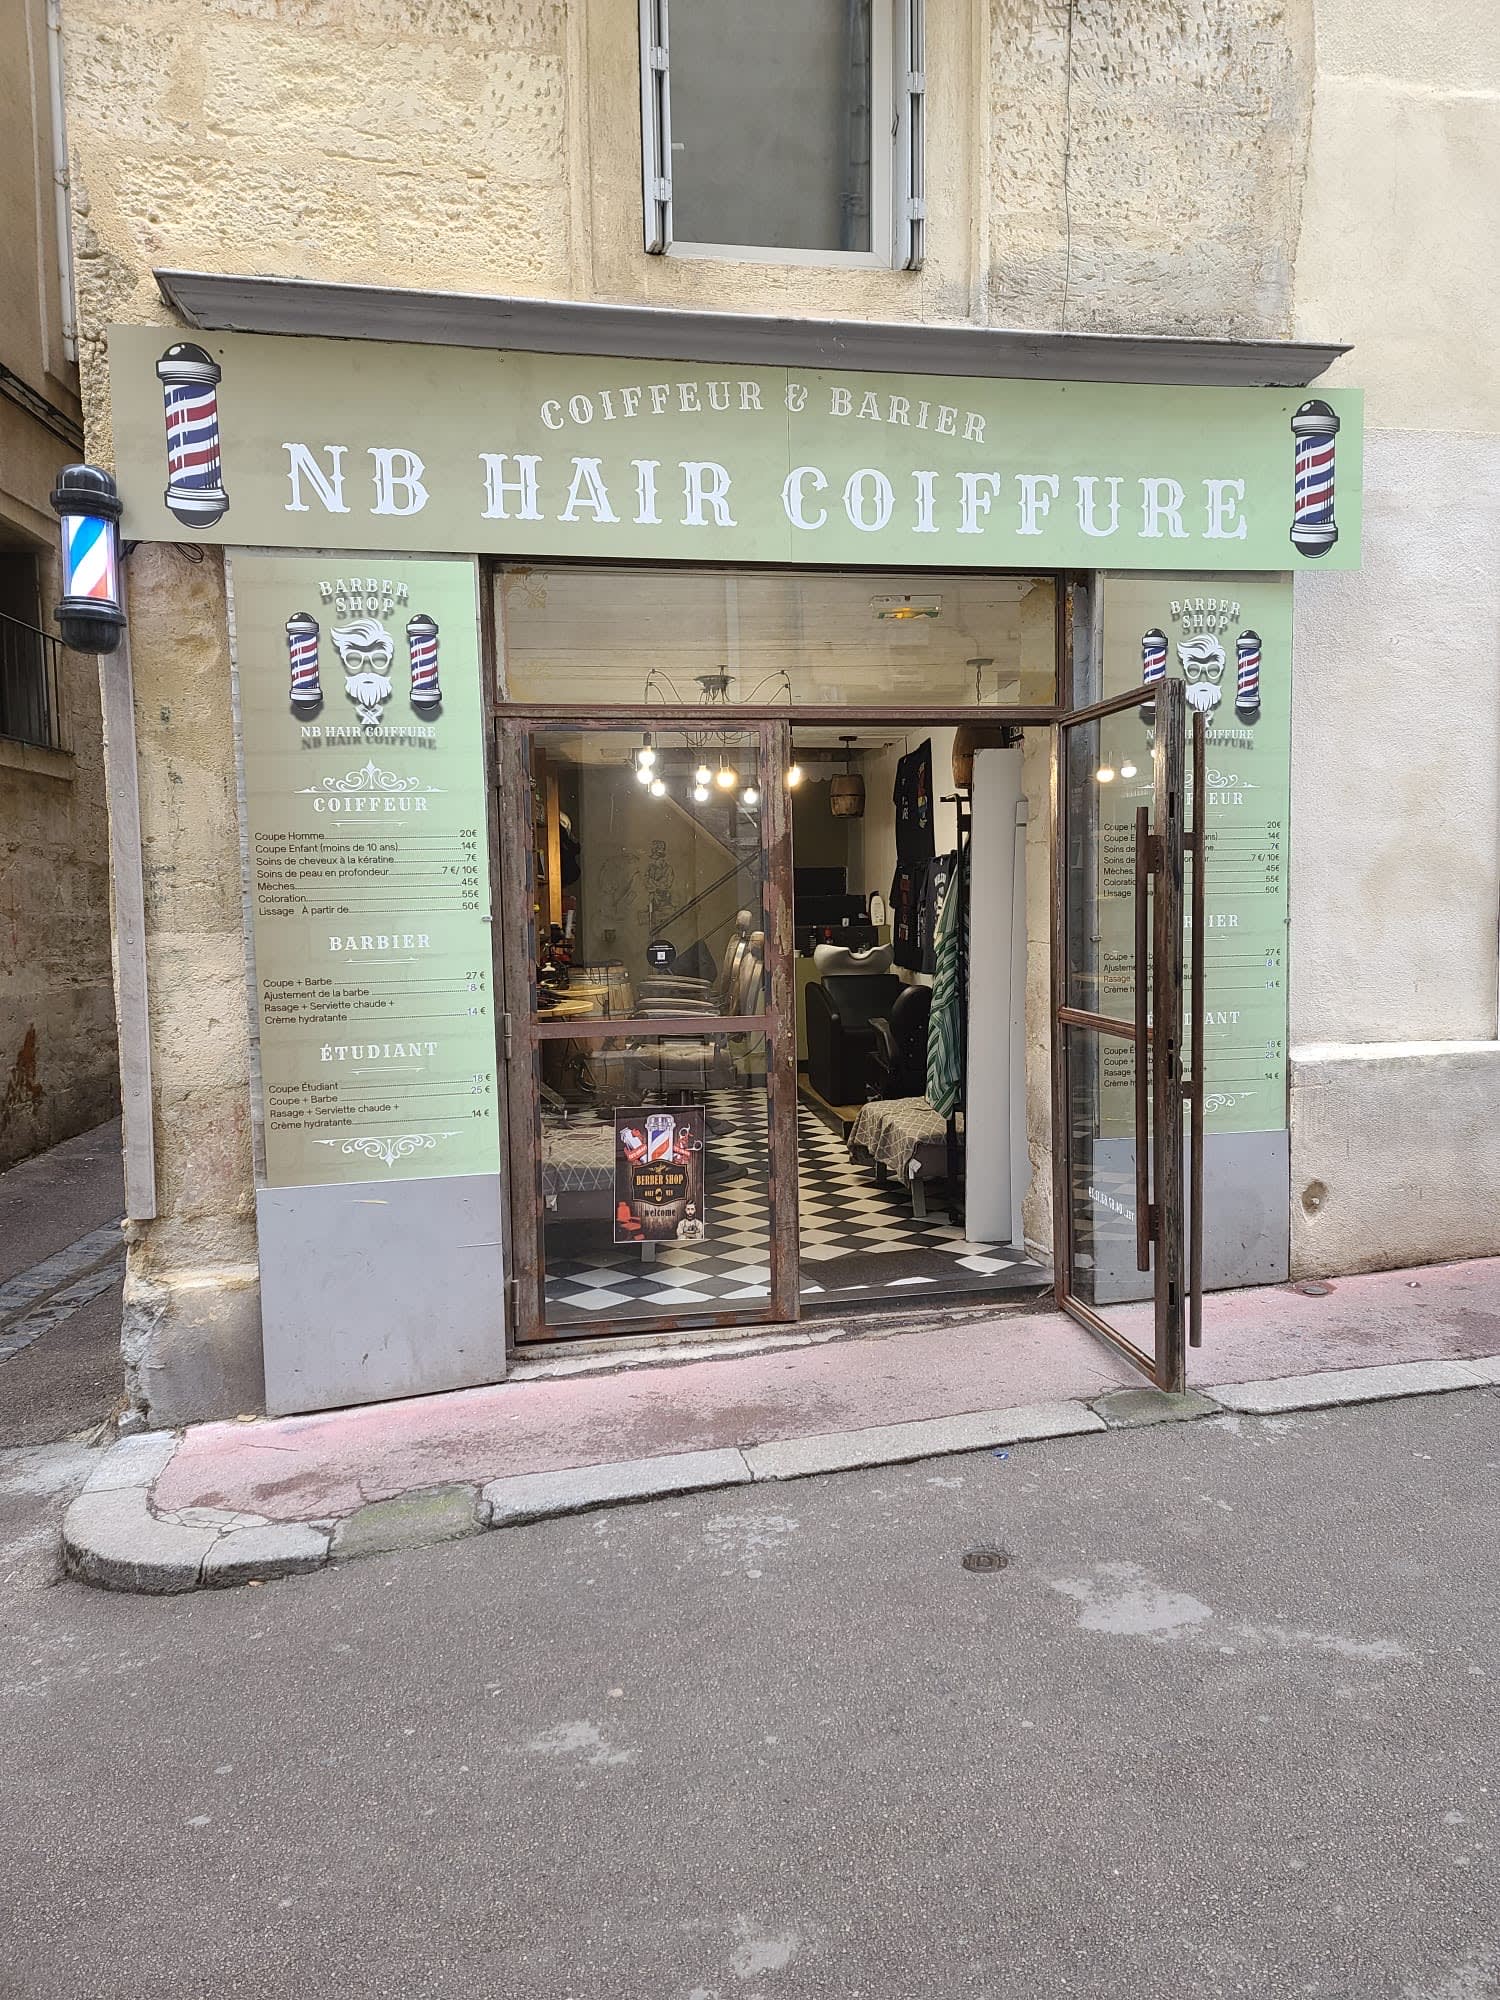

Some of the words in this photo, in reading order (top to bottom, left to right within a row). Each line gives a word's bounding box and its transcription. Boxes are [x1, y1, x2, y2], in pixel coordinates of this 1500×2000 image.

[540, 381, 763, 430] COIFFEUR
[784, 383, 808, 411] &
[830, 387, 987, 444] BARIER
[282, 442, 430, 516] NB
[478, 453, 737, 527] HAIR
[781, 466, 1248, 540] COIFFURE
[319, 578, 409, 598] BARBER
[335, 597, 395, 612] SHOP
[1170, 598, 1241, 616] BARBER
[1182, 614, 1229, 629] SHOP
[300, 726, 321, 737] NB
[326, 726, 361, 737] HAIR
[365, 726, 436, 737] COIFFURE
[1205, 729, 1254, 739] OIFFURE
[313, 798, 429, 813] COIFFEUR
[1103, 823, 1129, 832] Coupe
[1267, 821, 1281, 829] 20€
[254, 832, 286, 842] Coupe
[288, 831, 324, 840] Homme
[459, 829, 478, 838] 20€
[1103, 834, 1129, 843] Coupe
[255, 844, 287, 854] Coupe
[289, 843, 318, 853] Enfant
[319, 842, 350, 852] (moins
[352, 843, 365, 852] de
[366, 843, 377, 852] 10
[379, 842, 399, 853] ans)
[461, 841, 477, 850] 14€
[1103, 845, 1124, 854] Soins
[1125, 845, 1136, 853] de
[255, 856, 282, 866] Soins
[284, 856, 296, 865] de
[298, 856, 338, 865] cheveux
[340, 855, 345, 864] à
[347, 855, 356, 864] la
[358, 854, 395, 864] kératine
[465, 853, 477, 862] 7€
[1103, 856, 1124, 865] Soins
[1125, 856, 1136, 864] de
[1267, 853, 1280, 861] 10€
[256, 869, 283, 879] Soins
[285, 869, 297, 878] de
[299, 869, 323, 879] peau
[324, 869, 337, 878] en
[338, 867, 390, 878] profondeur
[441, 866, 448, 874] 7
[462, 866, 478, 874] 10€
[1103, 866, 1133, 875] Mèches
[1265, 864, 1280, 872] 45€
[257, 881, 295, 891] Mèches
[461, 878, 479, 887] 45€
[1103, 878, 1136, 887] Colorati
[1265, 875, 1280, 883] 55€
[258, 893, 307, 904] Coloration
[462, 889, 479, 898] 55€
[1103, 889, 1132, 899] Lissage
[1265, 886, 1280, 894] 50€
[258, 906, 295, 917] Lissage
[301, 905, 309, 915] À
[310, 905, 335, 916] partir
[336, 905, 349, 914] de
[462, 901, 480, 911] 50€
[328, 934, 431, 951] BARBIER
[1103, 953, 1128, 962] Coupe
[1265, 949, 1275, 957] 27
[263, 979, 294, 989] Coupe
[304, 977, 332, 987] Barbe
[465, 971, 477, 980] 27
[479, 971, 485, 979] €
[1103, 975, 1131, 985] Rasage
[263, 990, 316, 1001] Ajustement
[318, 990, 331, 999] de
[332, 989, 341, 998] la
[342, 988, 370, 997] barbe
[479, 983, 485, 991] €
[1103, 985, 1129, 995] Crème
[264, 1003, 299, 1014] Rasage
[309, 1000, 351, 1010] Serviette
[353, 1000, 386, 1009] chaude
[264, 1015, 296, 1025] Crème
[298, 1013, 347, 1024] hydratante
[480, 1007, 486, 1015] €
[319, 1042, 438, 1062] ÉTUDIANT
[1103, 1047, 1128, 1055] Coupe
[1103, 1058, 1128, 1067] Coupe
[1103, 1068, 1132, 1077] Rasage
[268, 1084, 300, 1094] Coupe
[301, 1081, 339, 1092] Étudiant
[472, 1074, 483, 1083] 18
[485, 1074, 491, 1082] €
[1103, 1079, 1132, 1088] Crème
[269, 1097, 300, 1107] Coupe
[310, 1094, 338, 1104] Barbe
[471, 1086, 483, 1094] 25
[485, 1085, 491, 1093] €
[269, 1109, 304, 1119] Rasage
[315, 1105, 356, 1116] Serviette
[358, 1103, 391, 1113] chaude
[270, 1120, 302, 1131] Crème
[304, 1117, 352, 1129] hydratante
[471, 1109, 482, 1118] 14
[484, 1109, 490, 1117] €
[665, 1174, 684, 1185] SHOP
[645, 1208, 676, 1217] welcome
